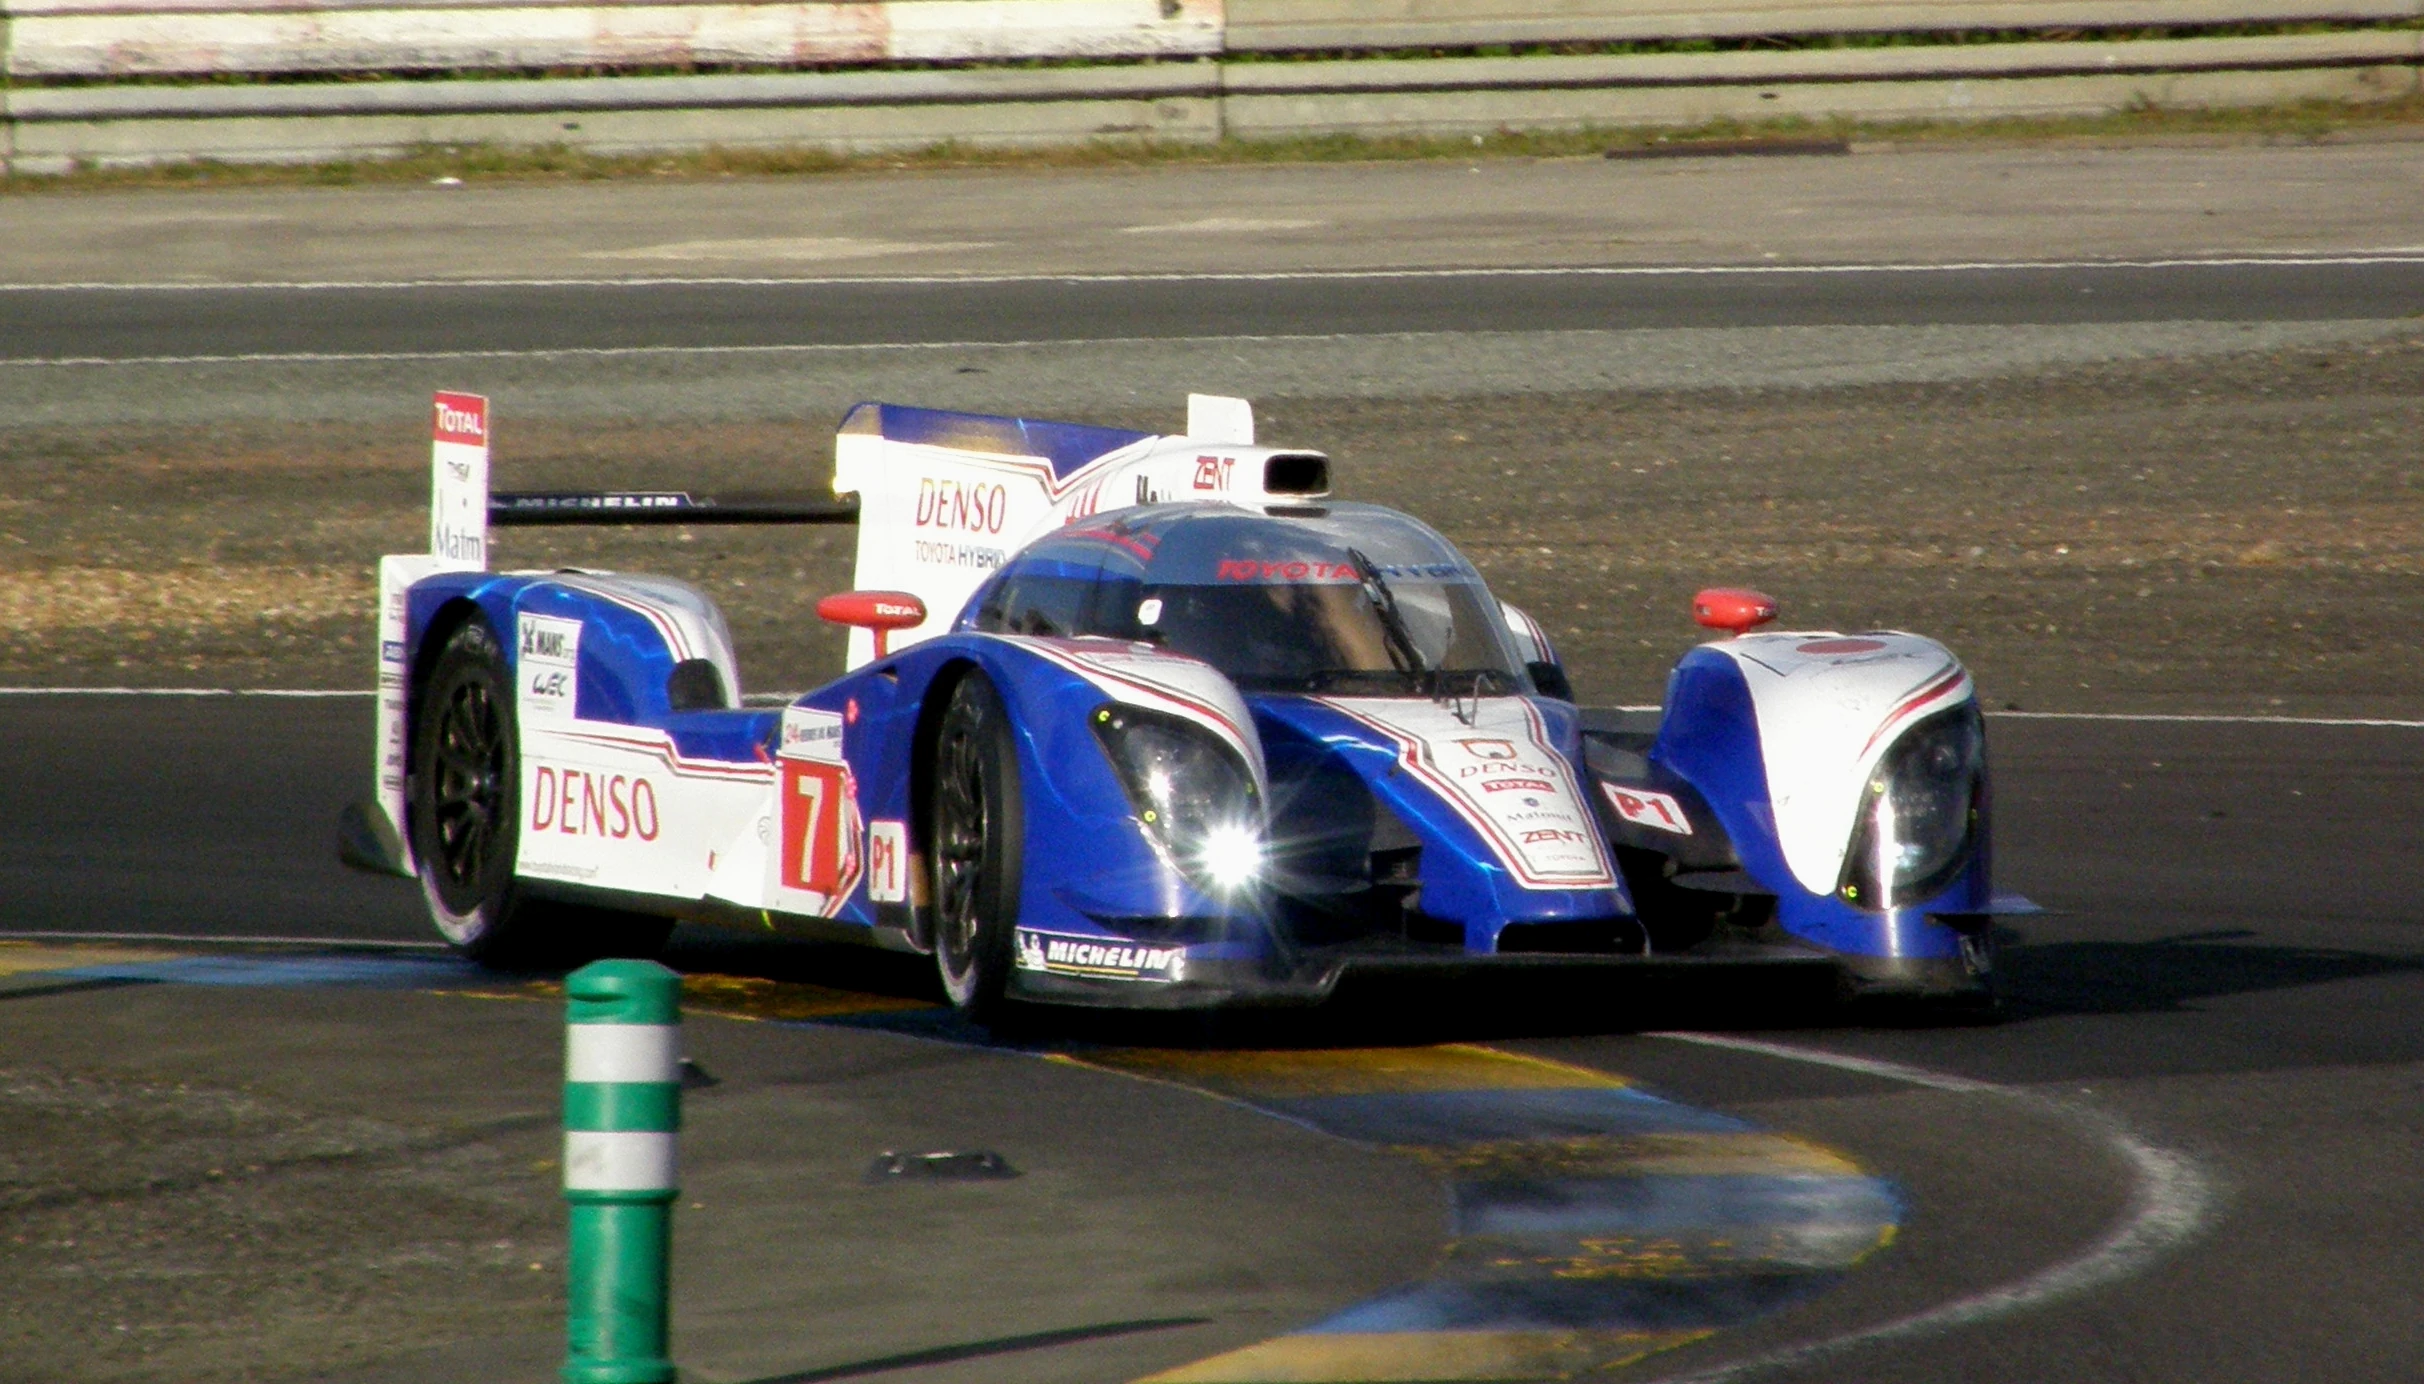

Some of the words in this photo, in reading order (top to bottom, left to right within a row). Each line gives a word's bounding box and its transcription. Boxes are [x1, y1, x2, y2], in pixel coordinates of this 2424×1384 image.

[435, 402, 483, 435] TOTAL
[1193, 456, 1236, 491] ZENT
[513, 496, 679, 509] MICHELIN
[916, 477, 1006, 534] DENSO
[915, 540, 956, 565] TOYOTA
[1216, 559, 1361, 581] TOYOTA
[874, 603, 922, 616] TOTAL
[1460, 763, 1557, 778] DENSO
[532, 766, 659, 842] DENSO
[1614, 791, 1674, 825] P1
[797, 775, 823, 884] 7
[1519, 829, 1588, 844] ZENT
[873, 835, 895, 890] P1
[1048, 940, 1173, 970] MICHELIN
